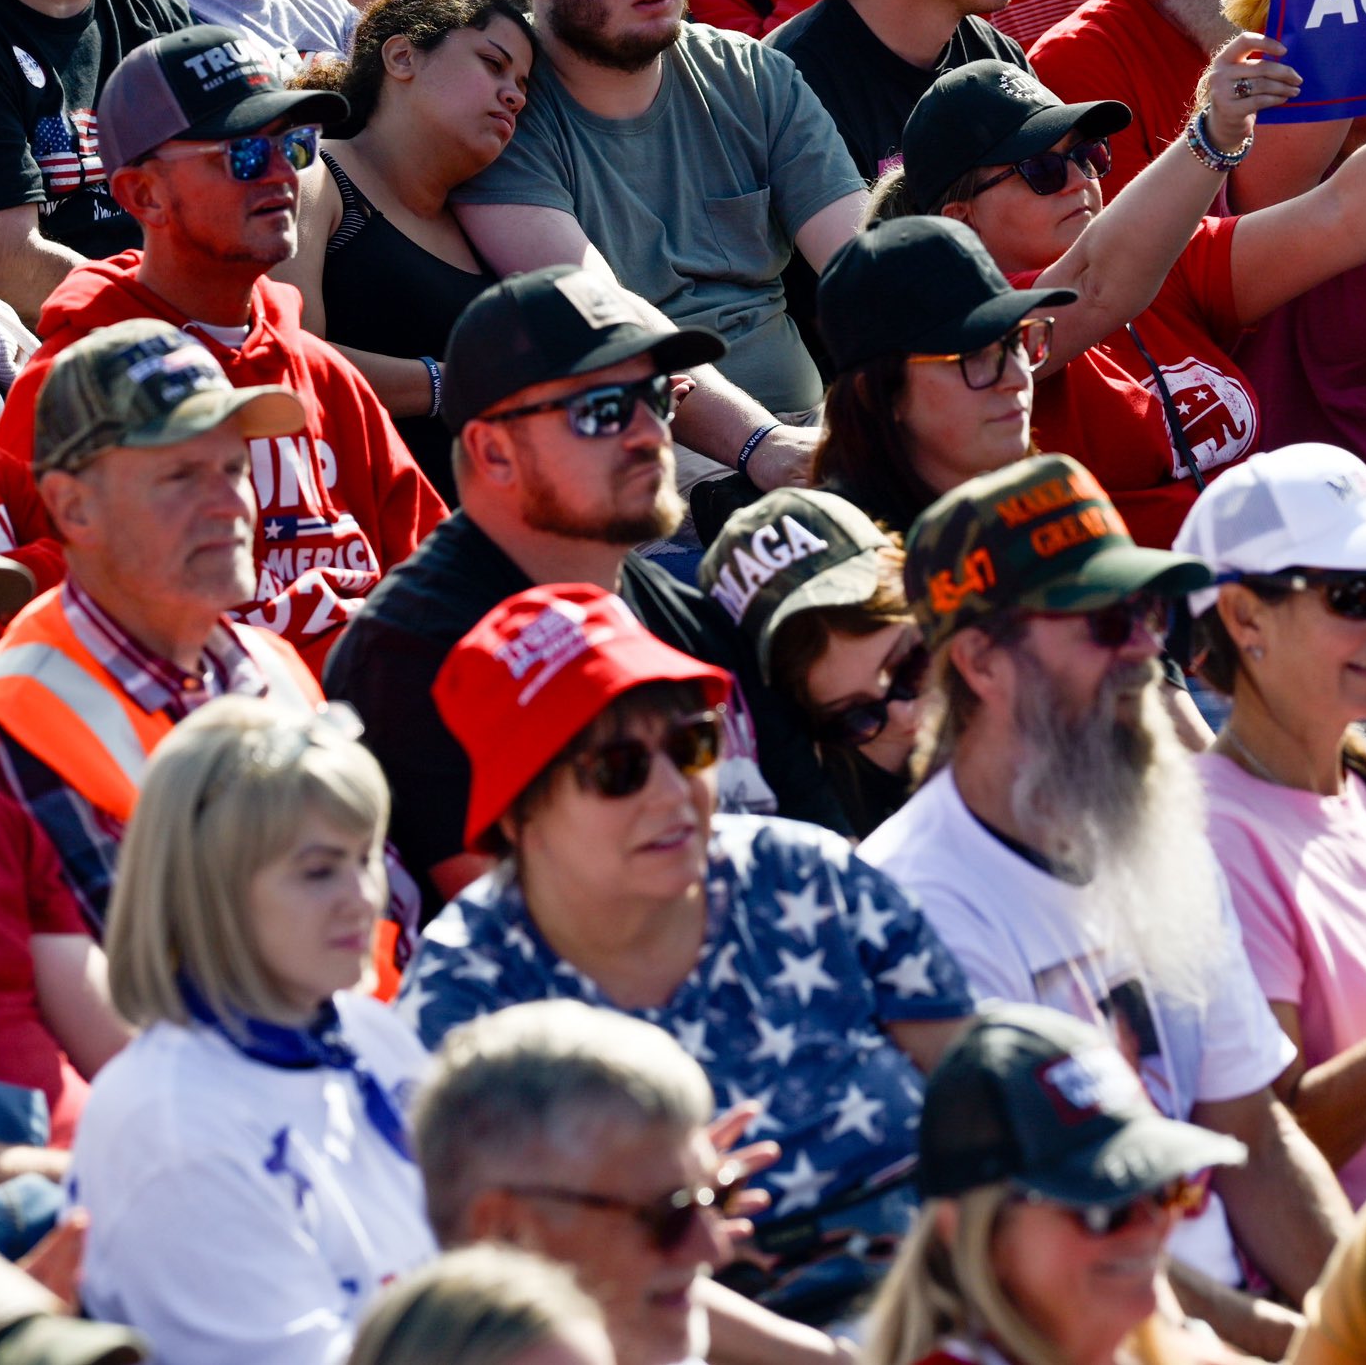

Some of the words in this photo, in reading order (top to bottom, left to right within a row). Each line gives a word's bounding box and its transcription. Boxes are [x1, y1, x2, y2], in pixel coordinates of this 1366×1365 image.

[184, 38, 255, 80] TRU
[739, 446, 751, 461] Hal
[710, 514, 829, 625] MAGA
